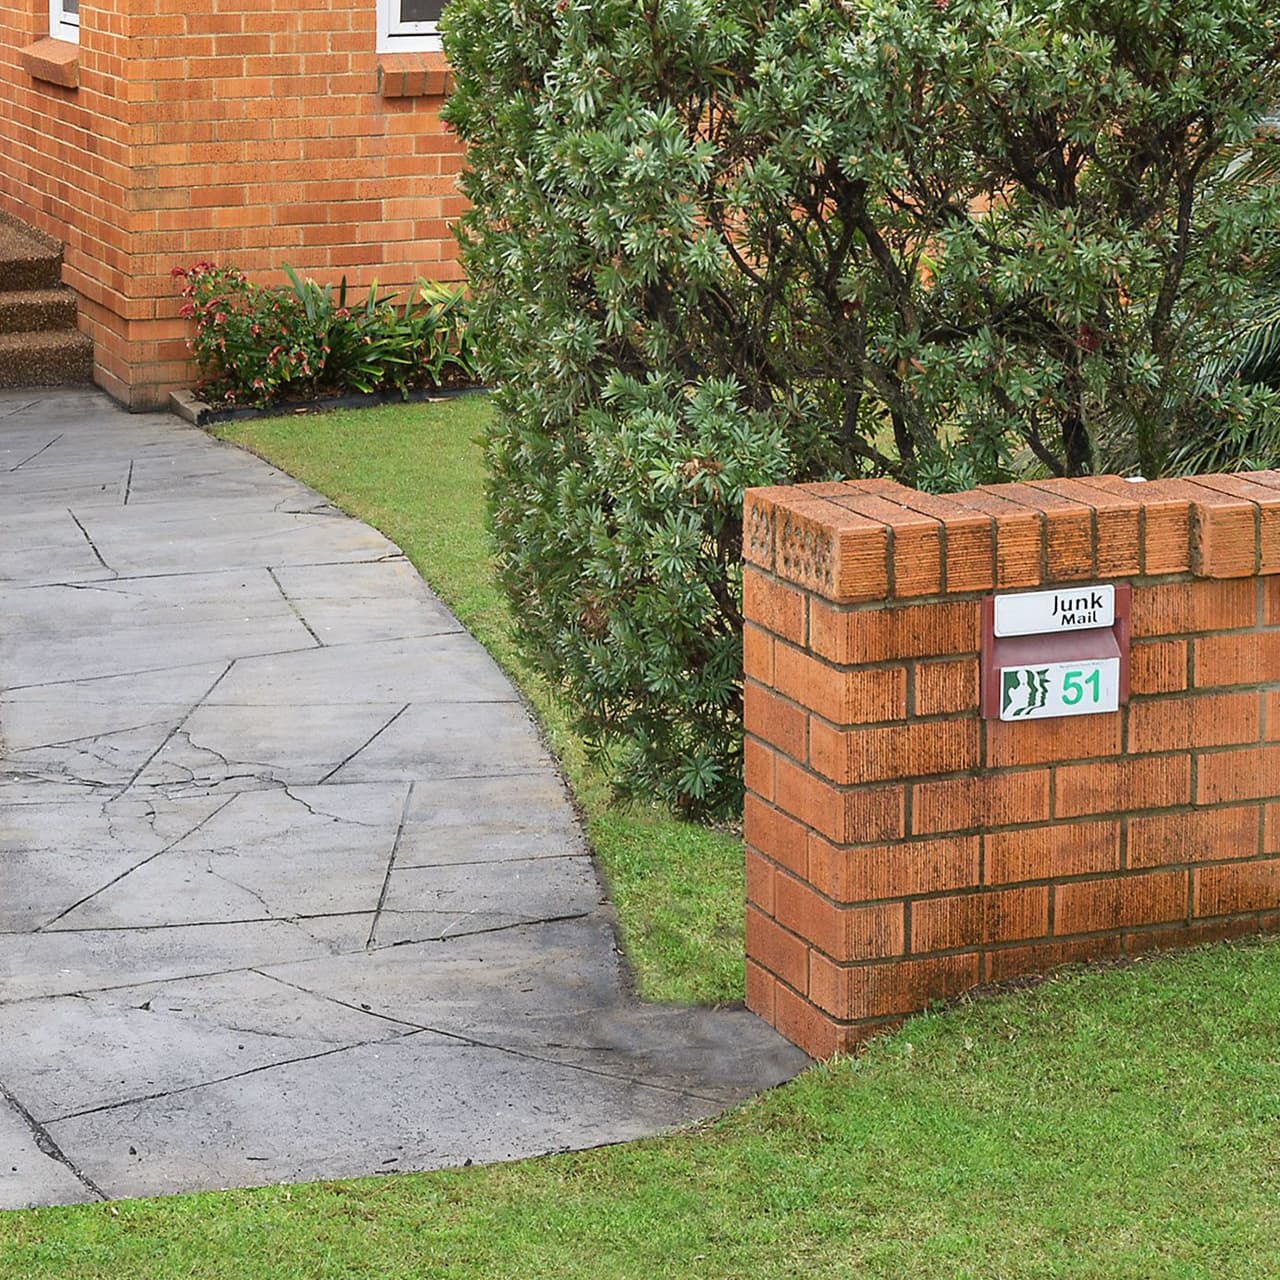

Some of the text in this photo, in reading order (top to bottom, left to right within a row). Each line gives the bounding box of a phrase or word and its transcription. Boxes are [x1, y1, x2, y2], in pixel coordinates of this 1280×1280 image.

[1052, 593, 1103, 615] Junk
[1061, 612, 1097, 625] Mail
[1061, 668, 1100, 705] 51
